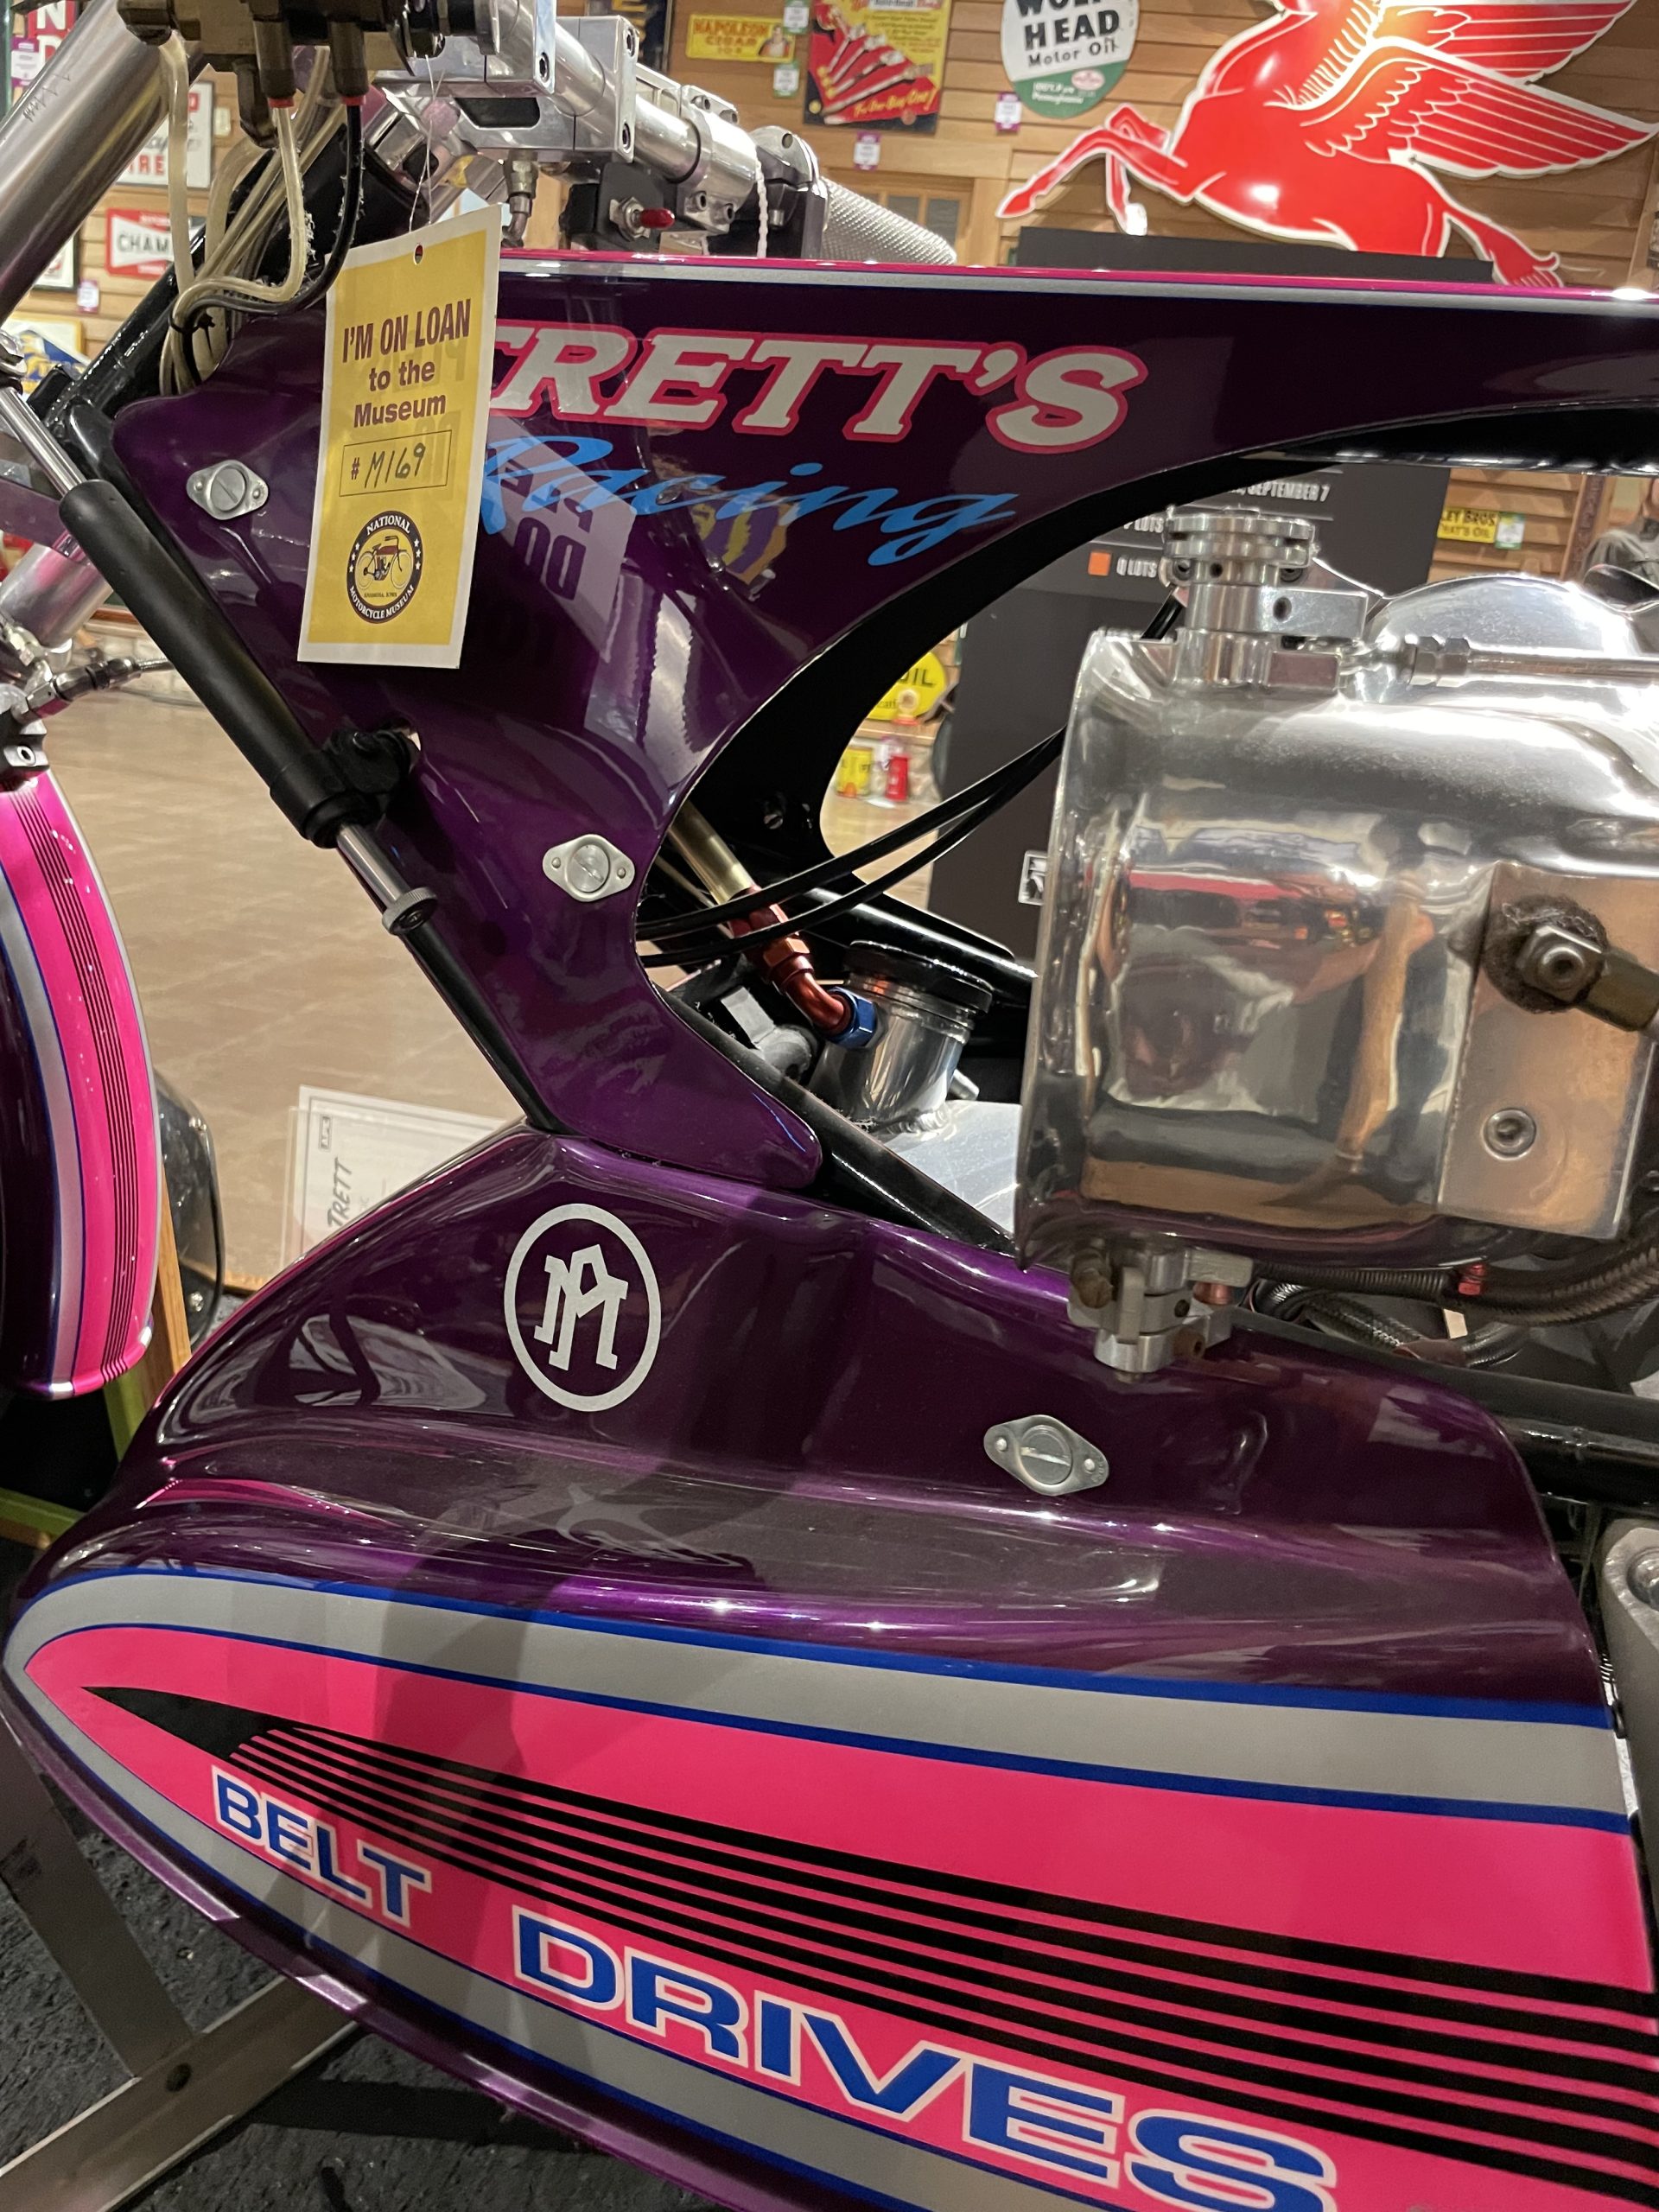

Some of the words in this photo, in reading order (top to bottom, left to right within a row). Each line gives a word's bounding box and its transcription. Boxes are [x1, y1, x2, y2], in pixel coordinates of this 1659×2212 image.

[1025, 10, 1120, 51] HEAD
[1028, 49, 1080, 67] Motor
[1089, 39, 1116, 56] Oil
[118, 233, 168, 252] CHAM
[342, 322, 374, 364] I'M
[379, 315, 409, 356] ON
[414, 298, 472, 348] LOAN
[369, 367, 391, 392] to
[397, 359, 435, 386] the
[490, 318, 1147, 455] RETT'S
[353, 394, 447, 429] Museum
[478, 435, 1018, 567] Racing
[1247, 480, 1319, 502] SEPTEMBER
[1319, 484, 1332, 503] 7
[365, 514, 411, 536] NATIONAL
[1126, 558, 1158, 579] LOTS
[349, 585, 385, 620] MOTORCYCLE
[385, 584, 415, 618] MUSEUM
[327, 1156, 353, 1228] TRETT
[211, 1764, 432, 1928] BELT
[512, 1904, 1338, 2212] DRIVES
